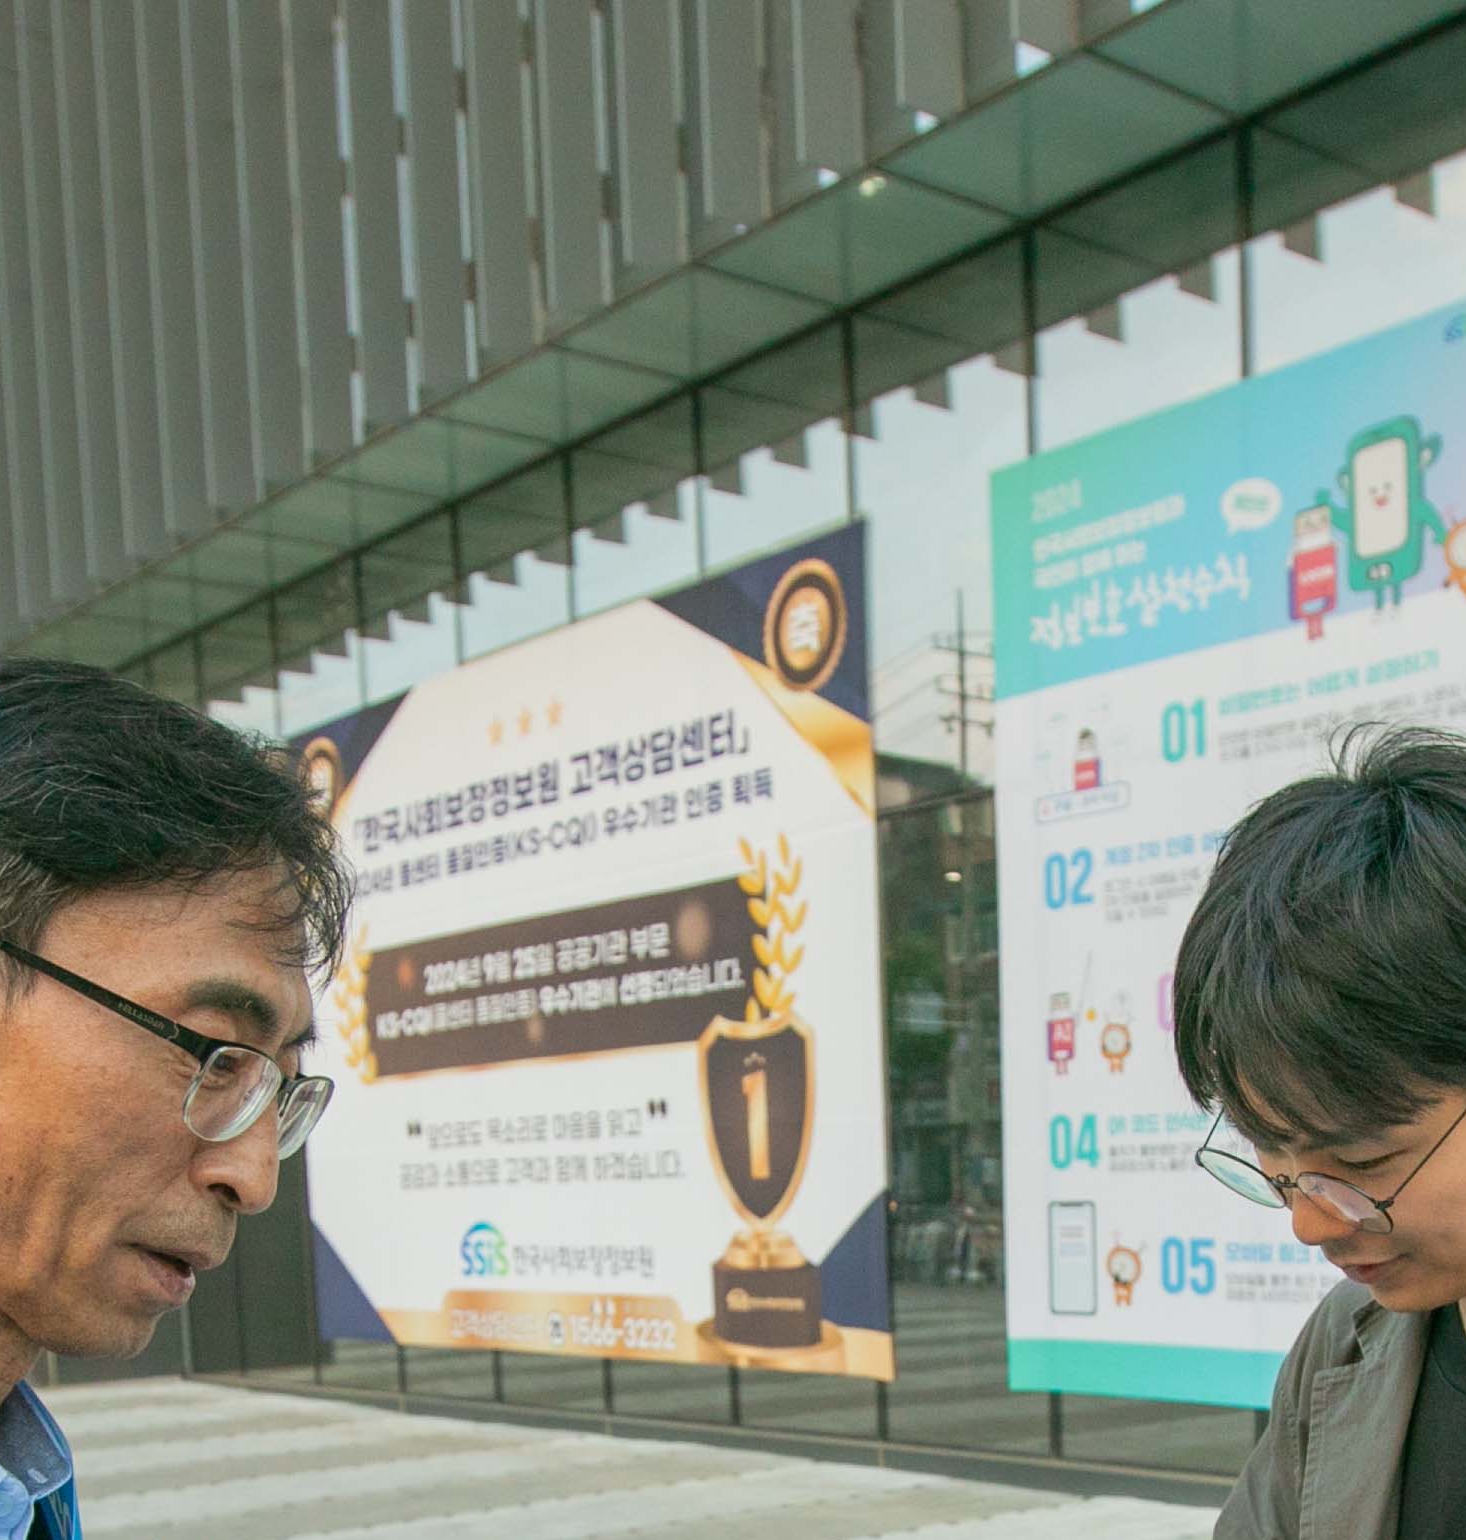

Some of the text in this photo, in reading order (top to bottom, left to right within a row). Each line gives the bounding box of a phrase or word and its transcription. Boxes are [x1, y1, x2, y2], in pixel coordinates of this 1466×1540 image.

[1161, 700, 1205, 762] 01
[603, 794, 675, 836] 우수기관
[686, 781, 723, 819] 인증
[1044, 849, 1093, 909] 02
[424, 958, 481, 994] 2024년
[557, 930, 627, 971] 공공기관
[630, 922, 669, 958] 부문
[1049, 1114, 1099, 1169] 04
[513, 1244, 654, 1277] 한국사회보장정보원
[1161, 1237, 1215, 1294] 05
[569, 1312, 676, 1351] 1566-3232
